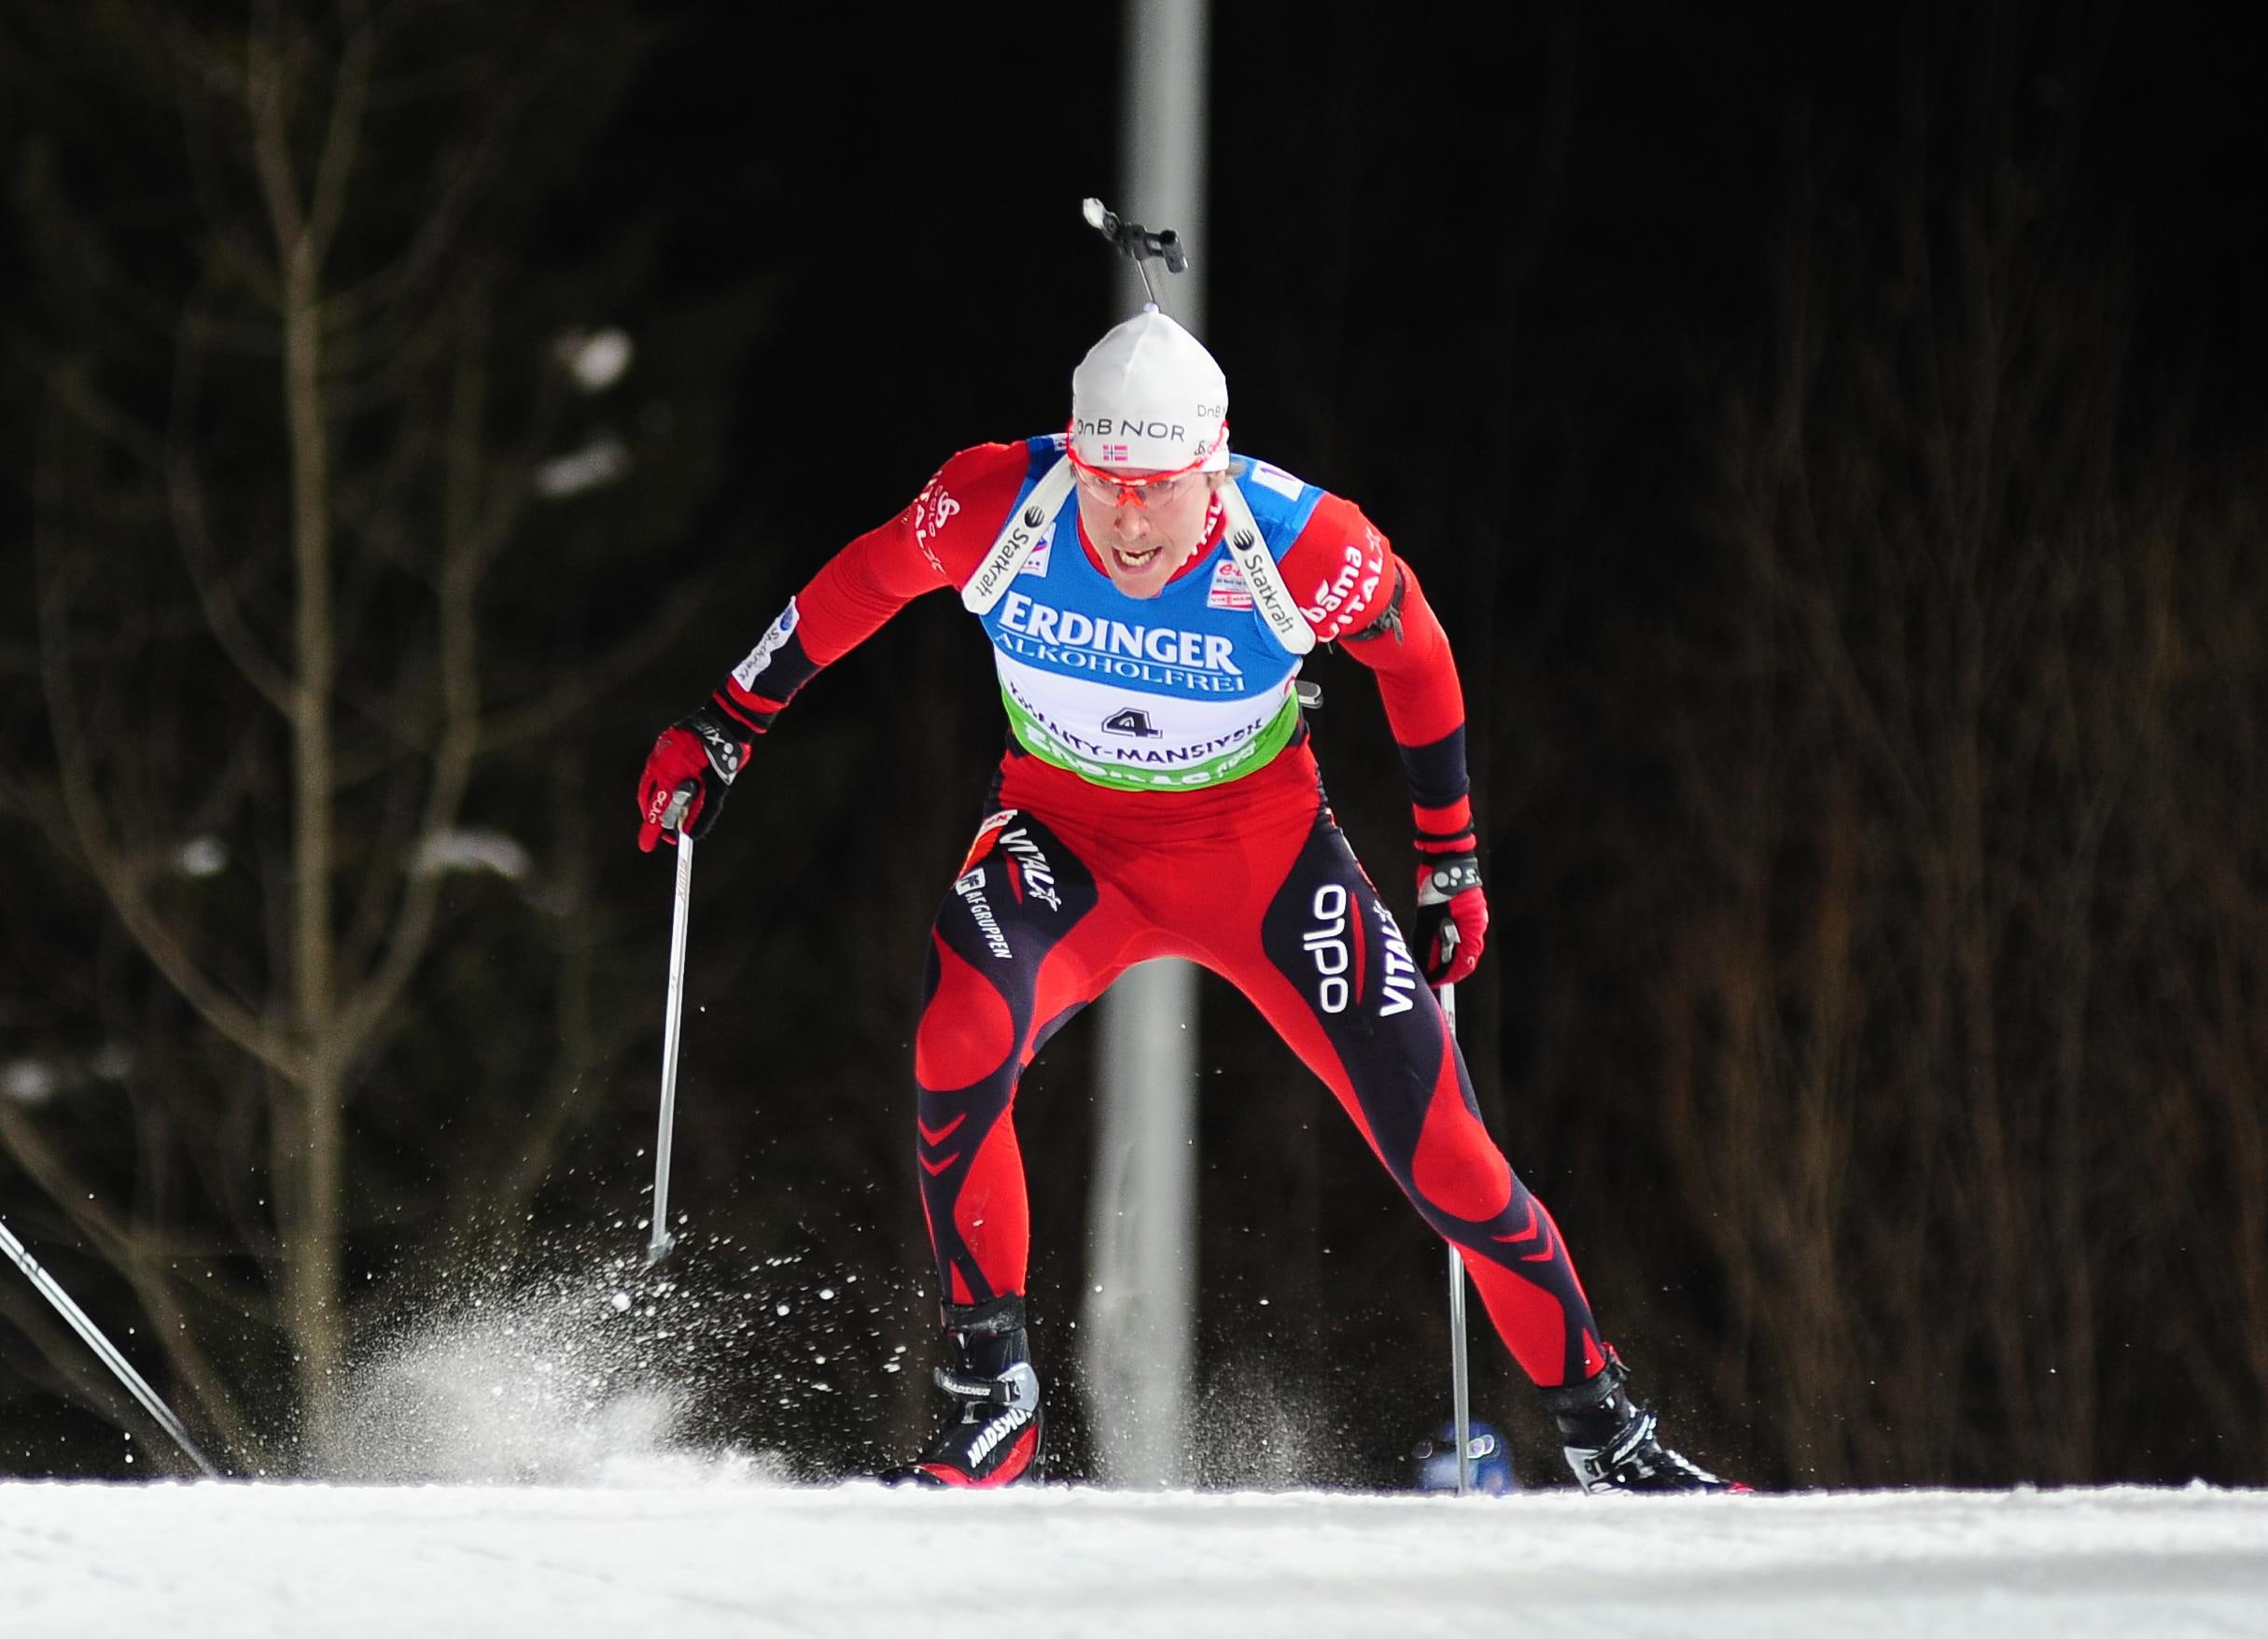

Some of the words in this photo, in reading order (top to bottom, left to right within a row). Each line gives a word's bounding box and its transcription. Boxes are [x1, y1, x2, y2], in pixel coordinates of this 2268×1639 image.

[1120, 420, 1185, 441] NOR
[975, 527, 1029, 597] Statkraft
[1244, 554, 1295, 635] Statkraft
[995, 633, 1245, 692] ALKOHOLFREI
[999, 590, 1243, 676] ERDINGER
[1101, 707, 1164, 739] 4
[1000, 828, 1055, 885] VITAL
[971, 904, 1014, 960] GRUPPEN
[1303, 883, 1348, 1014] odlo
[967, 1408, 1032, 1469] MADSHU
